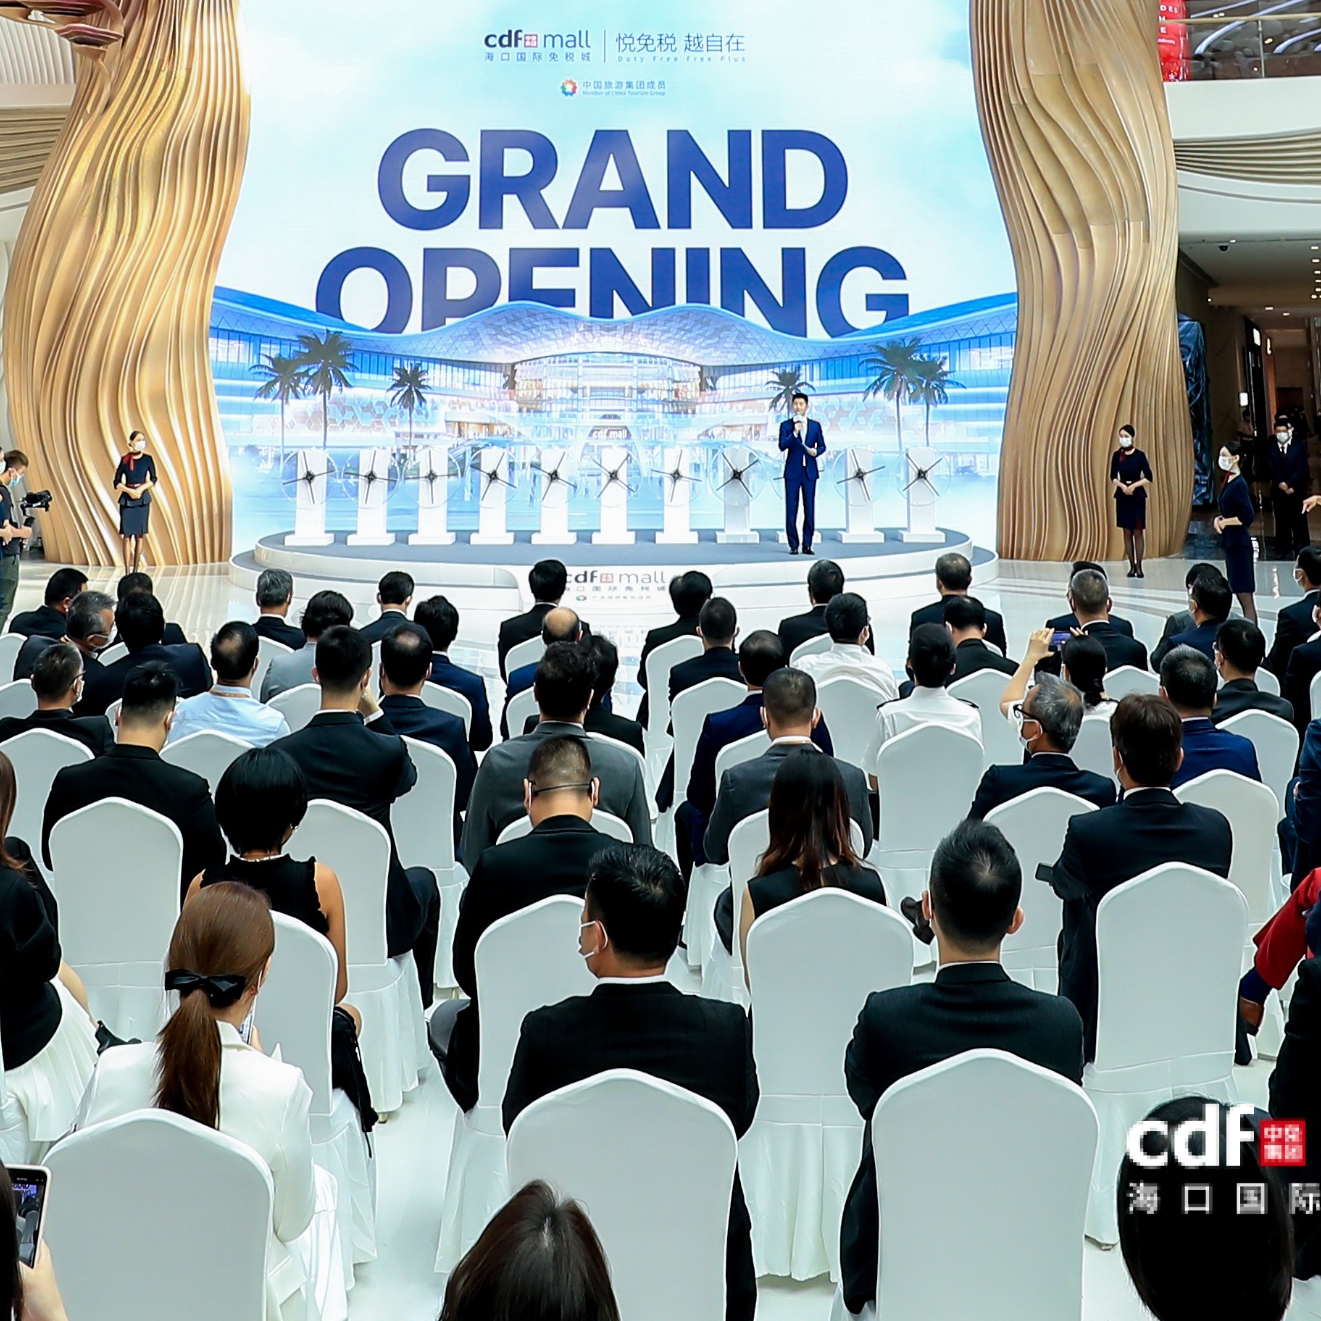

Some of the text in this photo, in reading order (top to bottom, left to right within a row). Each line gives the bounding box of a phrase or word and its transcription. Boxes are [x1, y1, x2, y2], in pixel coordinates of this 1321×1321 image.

[484, 29, 523, 49] cdf
[543, 29, 591, 49] mall
[615, 32, 746, 53] 悦免税 越自在
[377, 127, 849, 232] GRAND
[619, 570, 667, 584] mall
